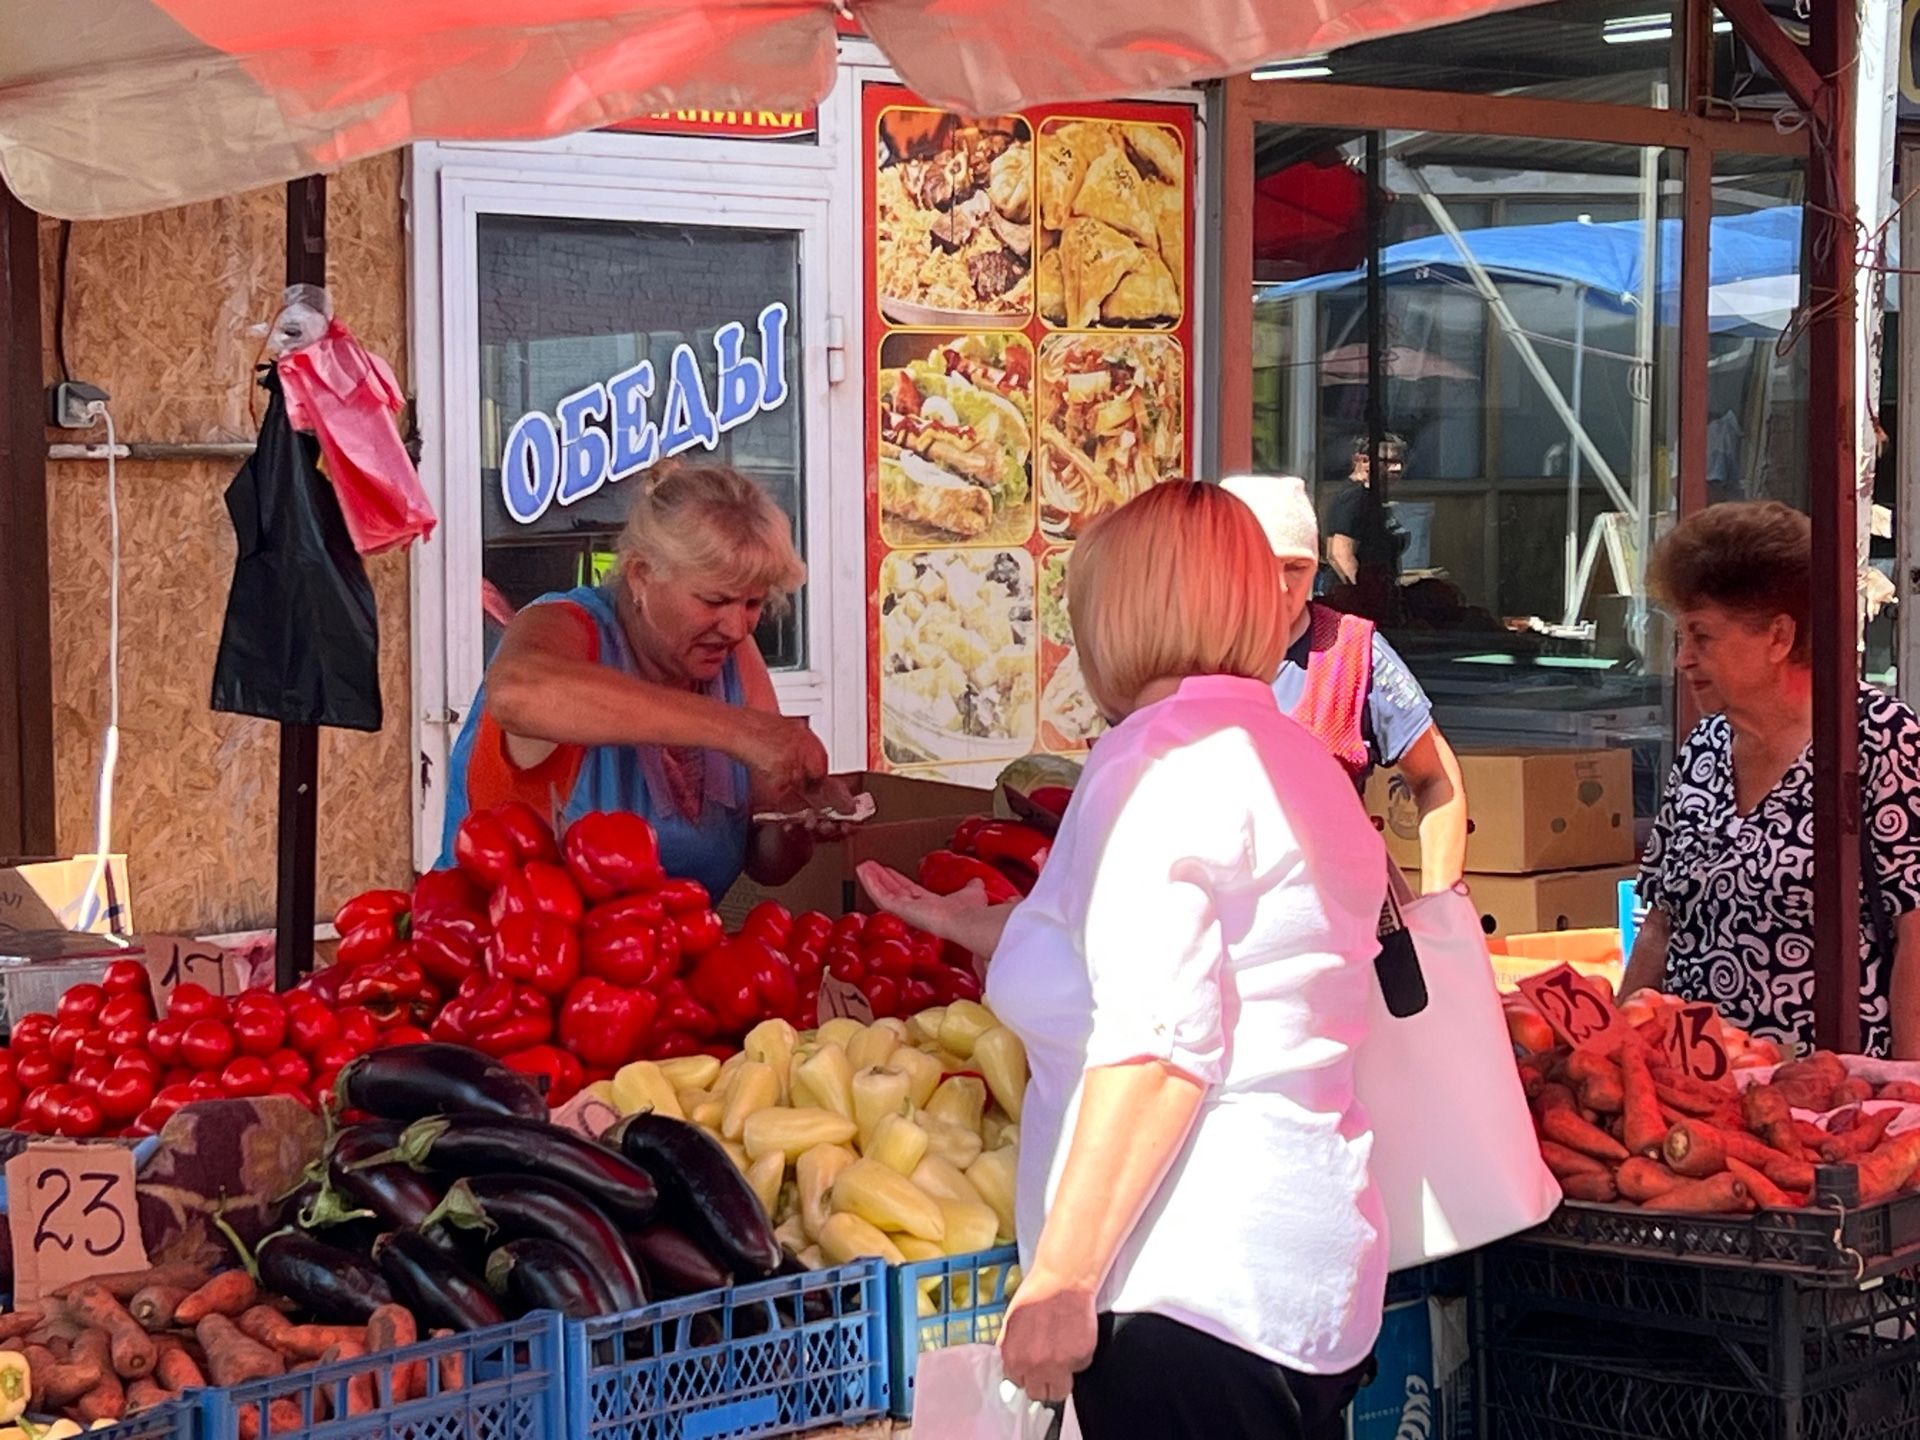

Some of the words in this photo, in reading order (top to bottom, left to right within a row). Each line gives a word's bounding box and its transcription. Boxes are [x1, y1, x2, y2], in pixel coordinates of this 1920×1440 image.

[502, 302, 789, 524] ОБЕДЫ
[161, 944, 225, 996] 17
[1534, 969, 1610, 1043] 23
[1668, 1005, 1728, 1082] 13
[33, 1168, 125, 1256] 23
